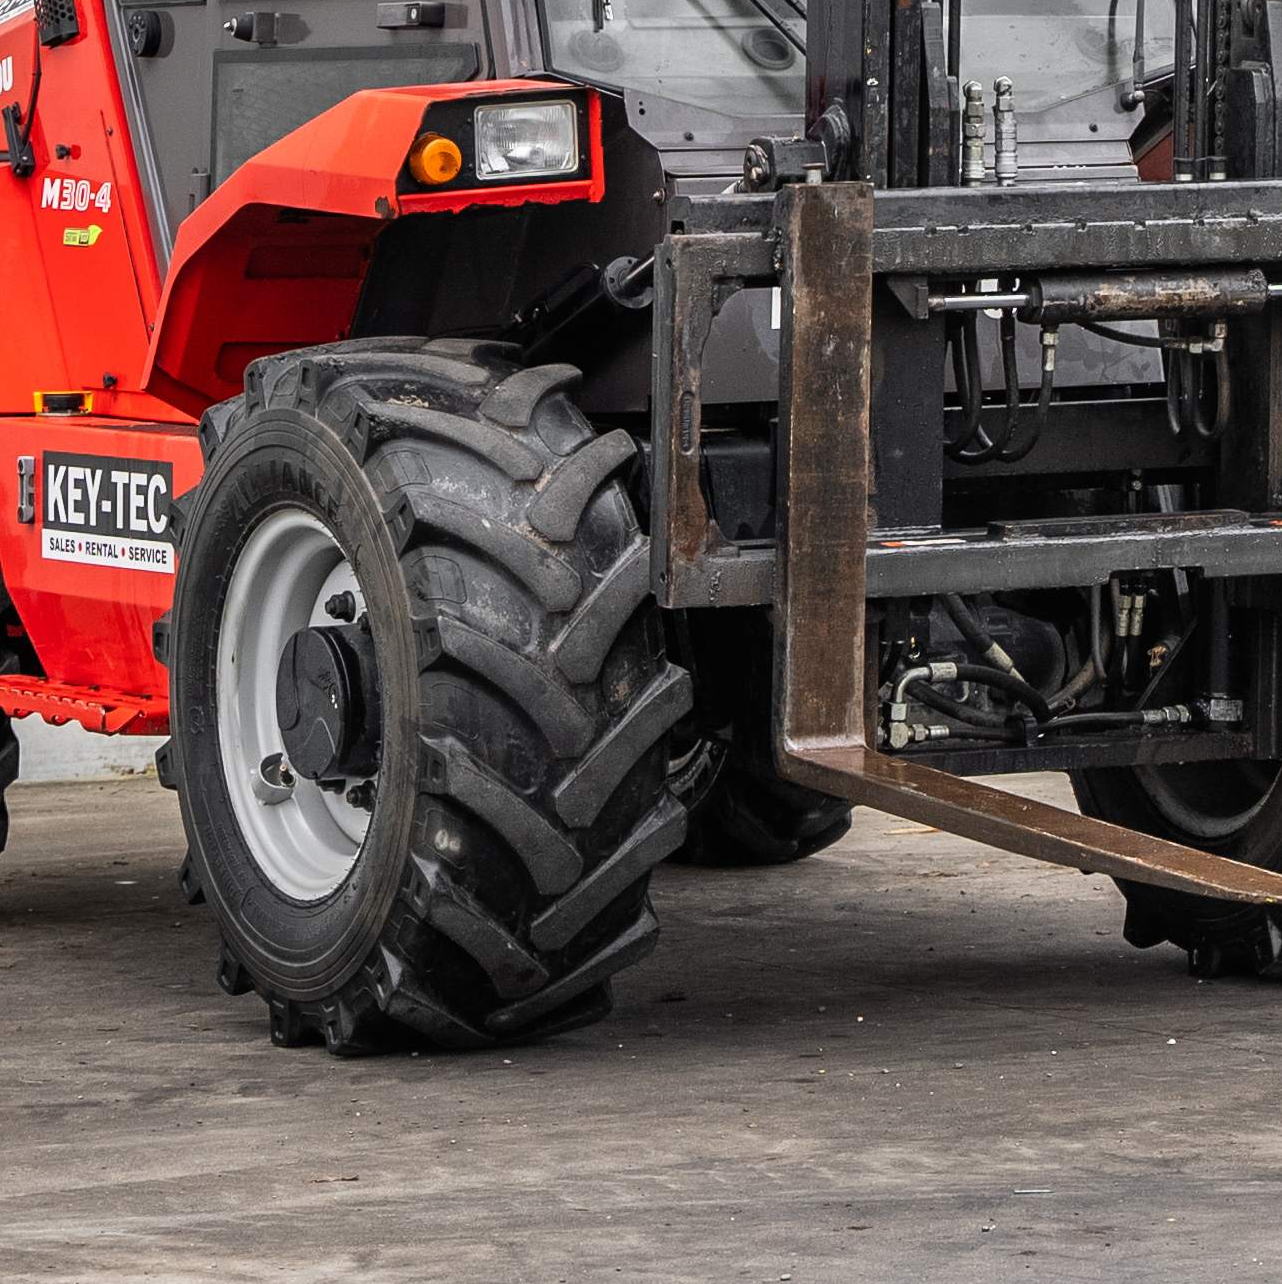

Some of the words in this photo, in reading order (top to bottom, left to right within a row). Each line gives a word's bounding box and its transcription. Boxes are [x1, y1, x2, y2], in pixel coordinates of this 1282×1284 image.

[41, 177, 112, 213] M30-4
[47, 464, 168, 534] KEY-TEC
[49, 537, 76, 553] SALES
[85, 541, 119, 559] RENTAL
[128, 546, 167, 565] SERVICE
